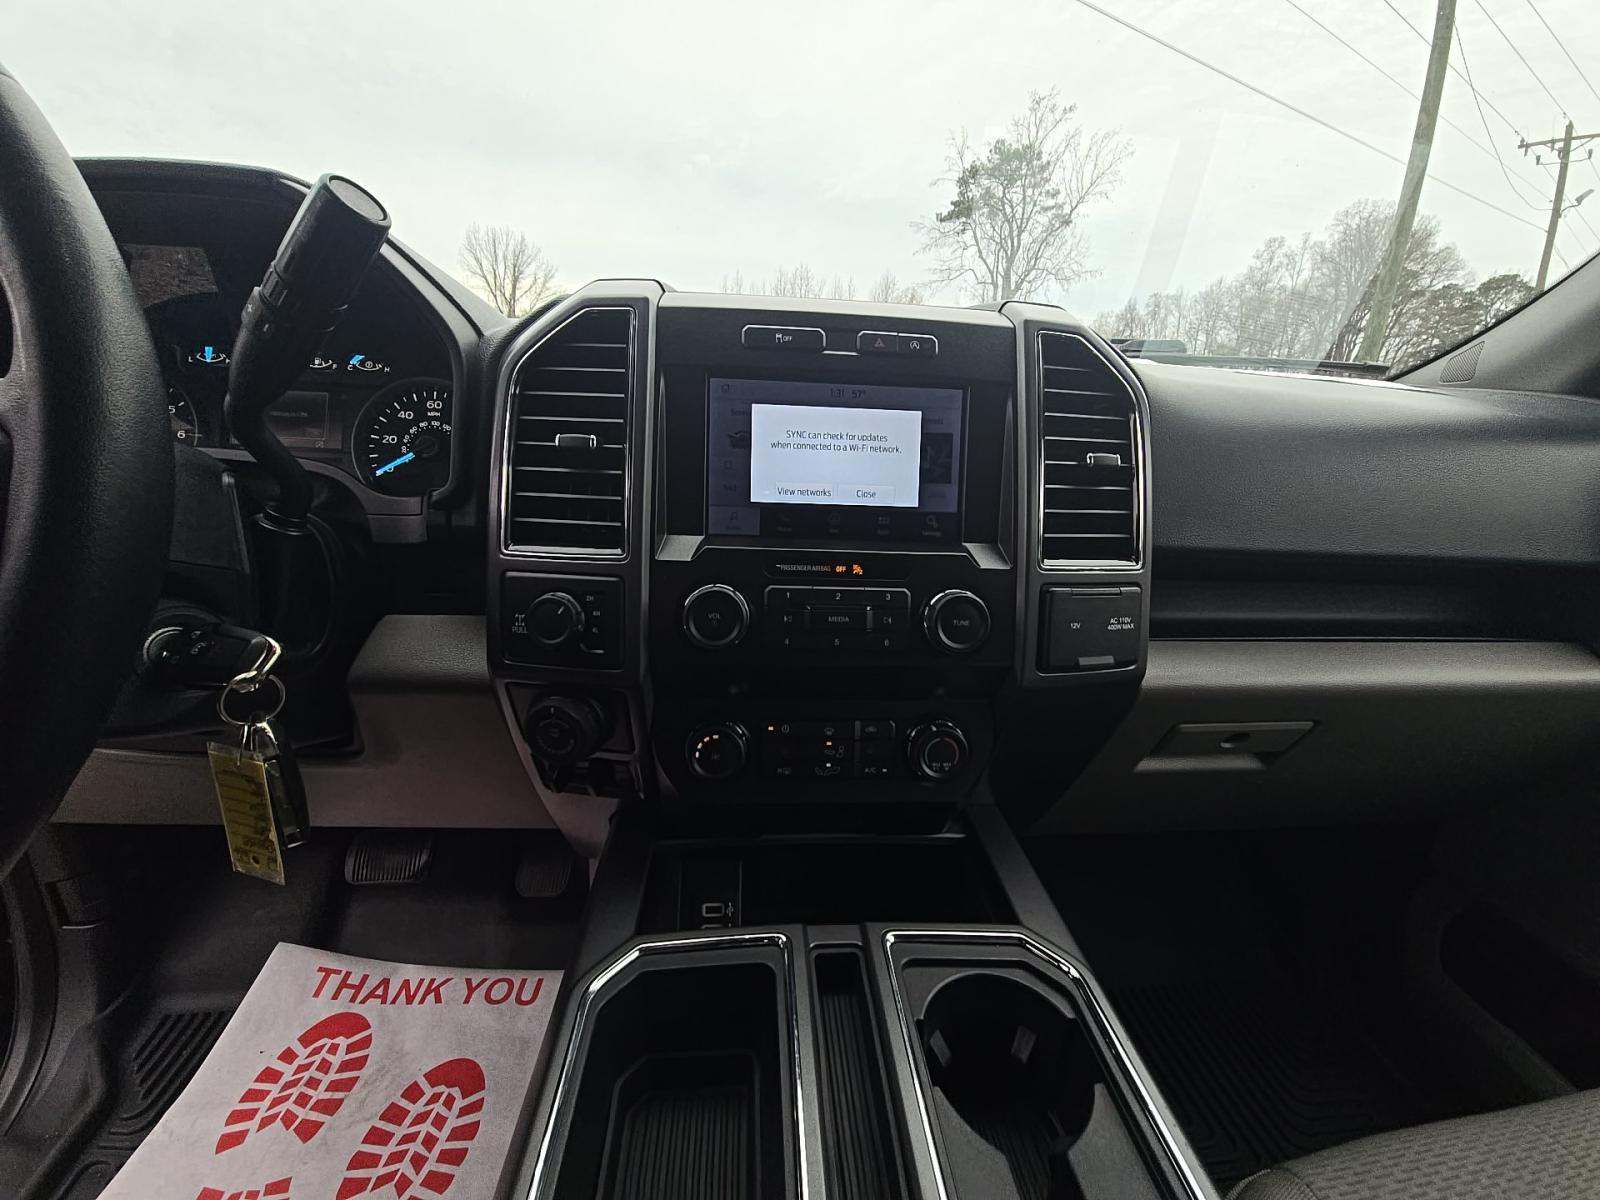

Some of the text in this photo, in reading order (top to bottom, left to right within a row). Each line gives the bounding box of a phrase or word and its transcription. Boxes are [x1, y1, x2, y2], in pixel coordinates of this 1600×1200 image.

[426, 400, 443, 409] 60
[168, 405, 176, 414] 5
[397, 411, 414, 420] 40
[177, 430, 186, 439] 6
[786, 430, 888, 444] SYNC can check for updates
[382, 435, 398, 444] 20
[770, 440, 792, 450] when
[792, 441, 832, 451] connected
[833, 443, 842, 452] to
[849, 444, 868, 453] Wi-Fi
[869, 444, 903, 455] network.
[777, 487, 832, 498] View networks
[856, 489, 877, 499] Close
[812, 564, 832, 572] AIRBAG
[835, 565, 847, 573] OFF
[835, 592, 841, 600] 2
[885, 592, 891, 600] 3
[828, 615, 850, 623] MEDIA
[1119, 616, 1132, 624] 110V
[512, 626, 529, 634] PULL
[1070, 622, 1081, 630] 12V
[312, 966, 544, 1006] THANK YOU
